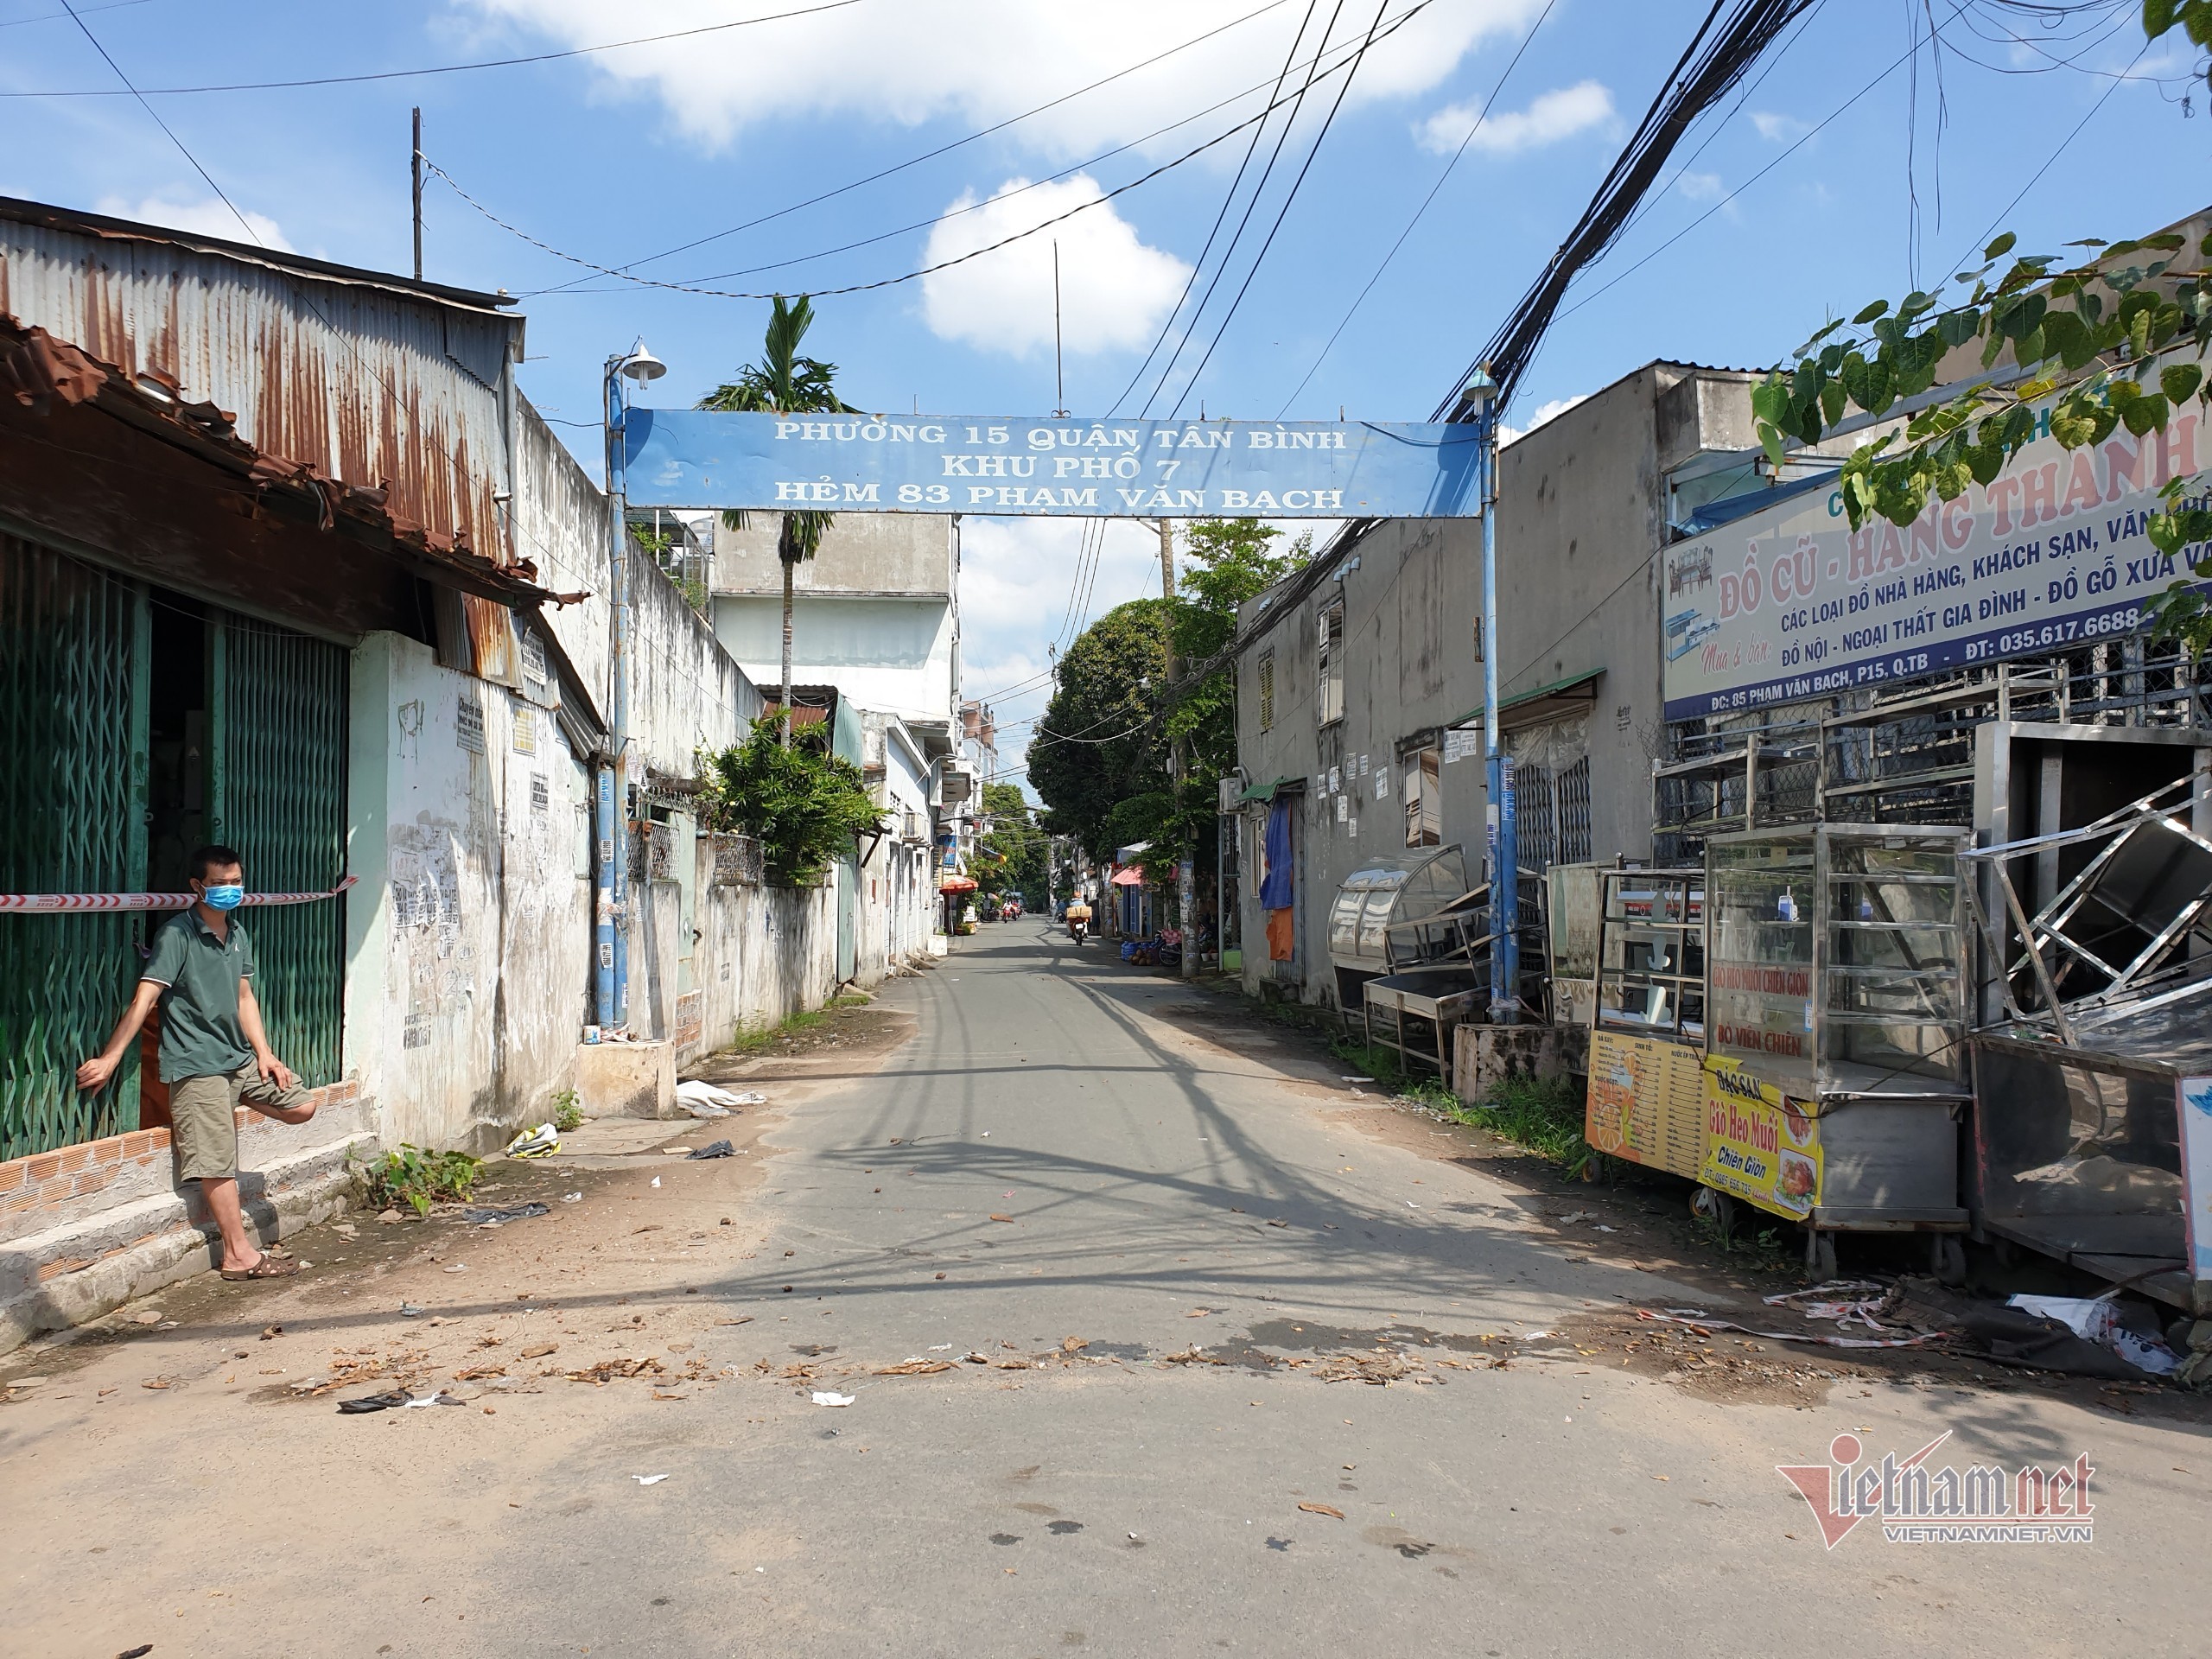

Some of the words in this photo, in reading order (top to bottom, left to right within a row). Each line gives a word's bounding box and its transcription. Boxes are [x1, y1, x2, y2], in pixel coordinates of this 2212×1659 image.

[775, 416, 947, 443] PHƯỜNG
[966, 426, 1009, 444] 15
[1027, 423, 1139, 453] QUẬN
[1154, 425, 1230, 449] TÂN
[1249, 424, 1346, 450] BÌNH
[942, 454, 1036, 477] KHU
[1054, 444, 1141, 479] PHỐ
[1156, 460, 1180, 480] 7
[775, 474, 880, 503] HẺM
[898, 484, 950, 504] 83
[968, 486, 1098, 513] PHẠM
[1116, 484, 1206, 509] VĂN
[1222, 489, 1344, 515] BẠCH
[1719, 542, 1763, 620] ĐỒ
[1771, 535, 1818, 604] CŨ
[1781, 608, 1808, 632] CÁC
[1812, 598, 1843, 625] LOẠI
[1848, 582, 1869, 614] ĐỒ
[1875, 575, 1908, 607] NHÀ
[1913, 566, 1966, 596] HÀNG,
[1973, 543, 2040, 581] KHÁCH
[2047, 526, 2099, 560] SẠN,
[1781, 639, 1800, 667] ĐỒ
[1804, 636, 1828, 664] NỘI
[1842, 623, 1887, 653] NGOẠI
[1893, 605, 1936, 640] THẤT
[1942, 602, 1973, 629] GIA
[1979, 588, 2026, 620] ĐÌNH
[2048, 567, 2078, 604] ĐỒ
[2086, 554, 2118, 595] GỖ
[1700, 642, 1729, 676] Mua
[1711, 695, 1730, 711] ĐC:
[1732, 690, 1746, 707] 85
[1749, 684, 1783, 704] PHẠM
[1785, 678, 1810, 697] VĂN
[1814, 671, 1853, 692] BẠCH,
[1857, 661, 1889, 683] P15,
[1892, 653, 1929, 676] Q.TB
[1966, 639, 1994, 660] ĐT:
[1999, 607, 2140, 653] 035.617.6688
[1718, 1020, 1732, 1045] BÒ
[1736, 1025, 1761, 1051] VIÊN
[1764, 1030, 1802, 1057] CHIÊN
[1709, 1099, 1726, 1136] Giò
[1729, 1104, 1749, 1144] Heo
[1745, 1155, 1767, 1179] Giòn
